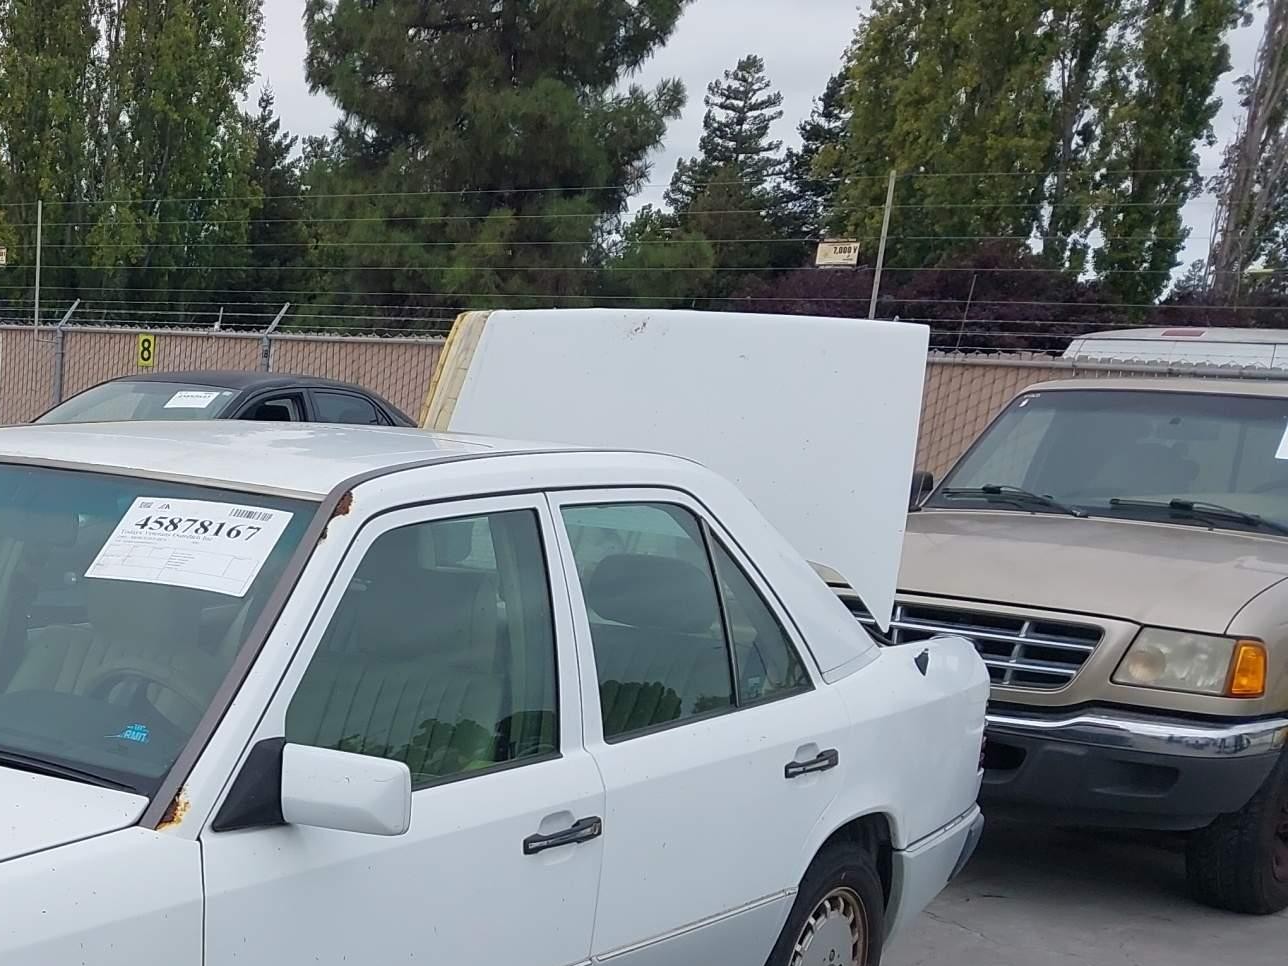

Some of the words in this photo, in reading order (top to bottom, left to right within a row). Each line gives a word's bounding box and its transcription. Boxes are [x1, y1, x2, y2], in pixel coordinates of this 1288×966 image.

[833, 246, 852, 255] 7,000
[140, 338, 152, 362] 8
[134, 515, 262, 542] 45878167
